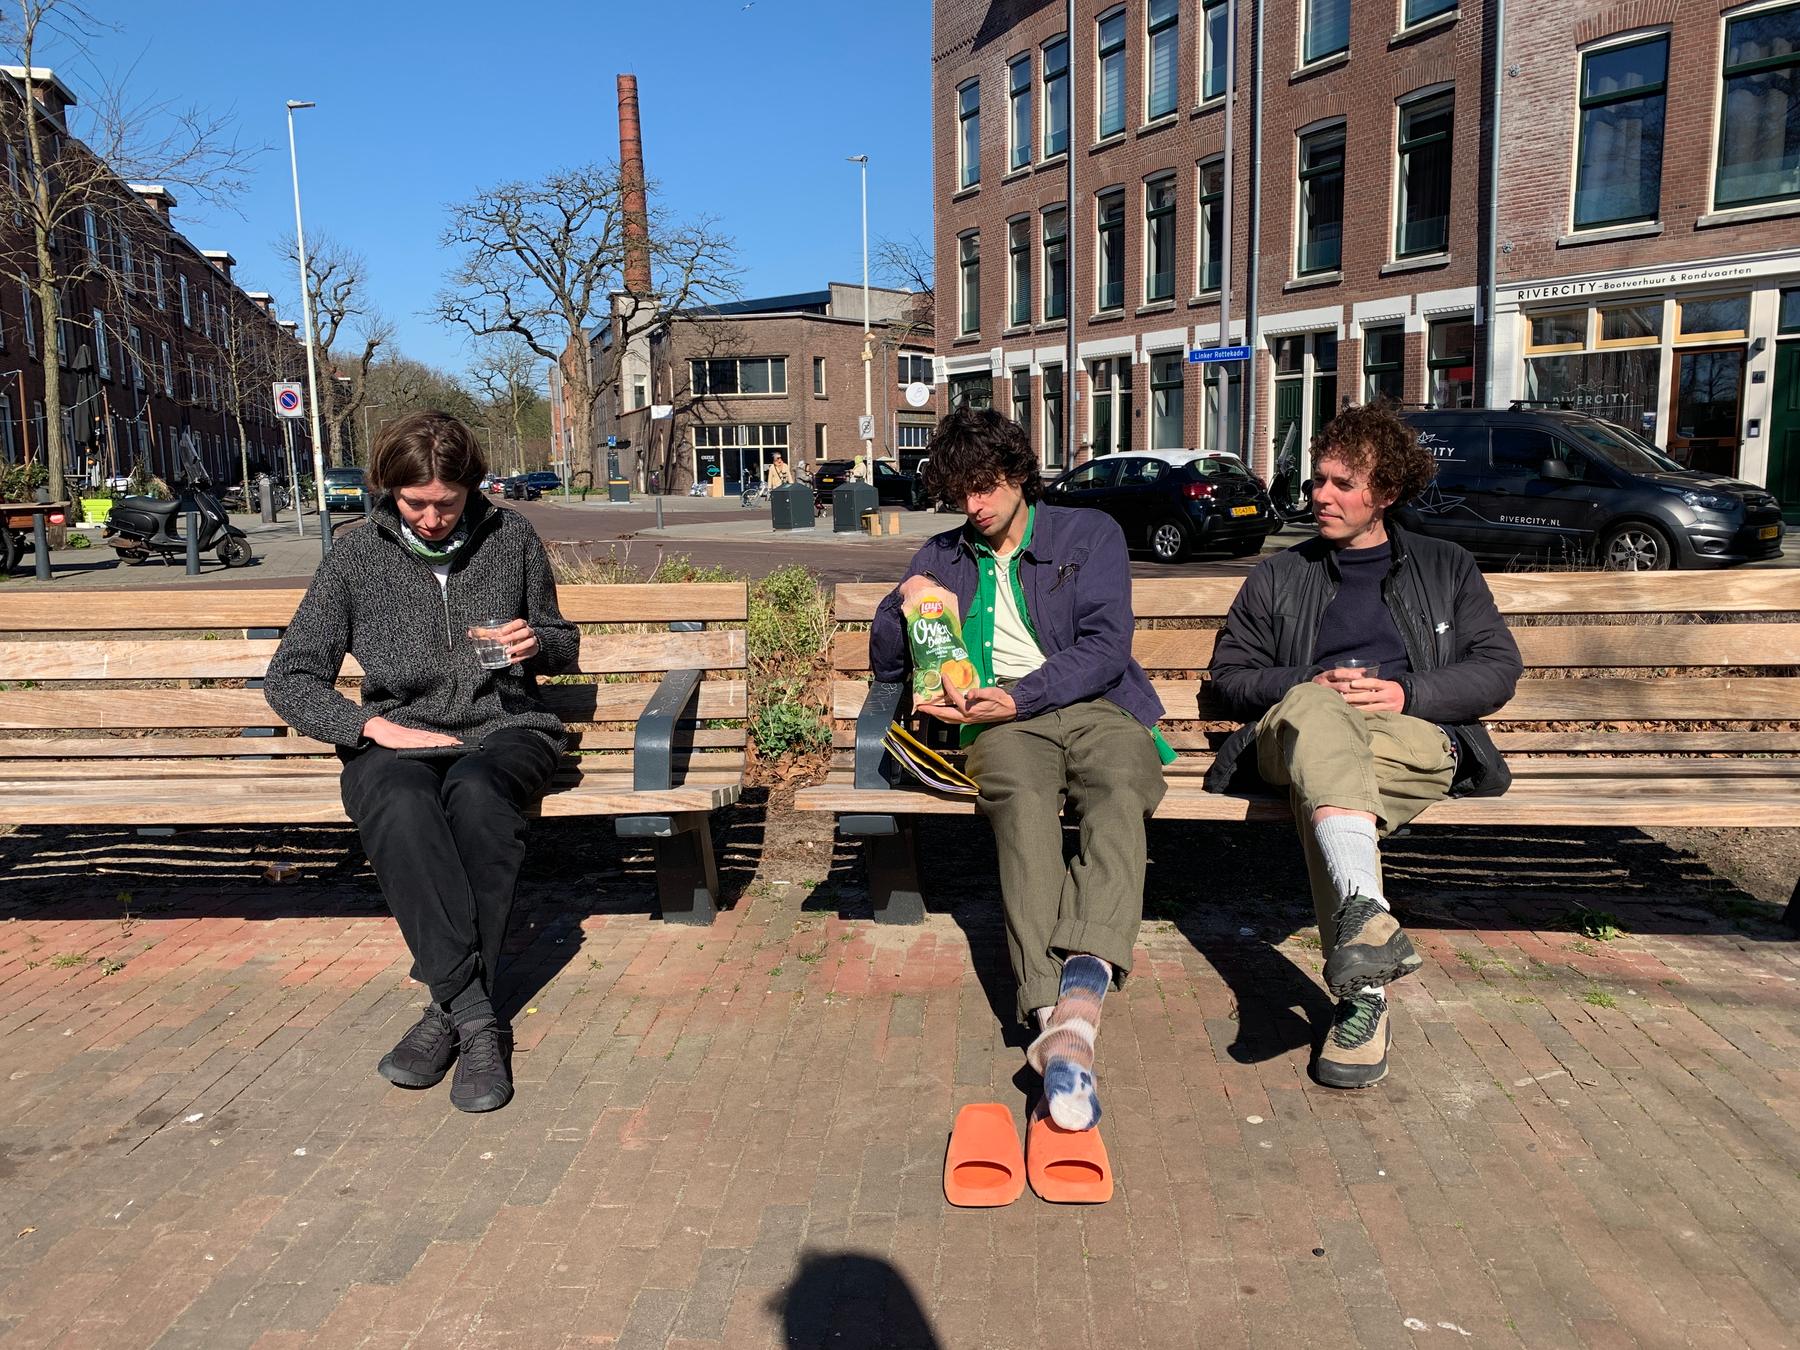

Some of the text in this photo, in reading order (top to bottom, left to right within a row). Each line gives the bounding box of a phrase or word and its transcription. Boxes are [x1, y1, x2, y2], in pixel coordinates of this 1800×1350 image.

[1517, 282, 1597, 300] RIVERCITY
[1669, 274, 1676, 282] &
[1681, 268, 1752, 281] Rondvaarten
[1194, 350, 1244, 360] Linker Rottekade
[1500, 515, 1561, 527] RIVERCITY.NL
[913, 618, 954, 645] Oven
